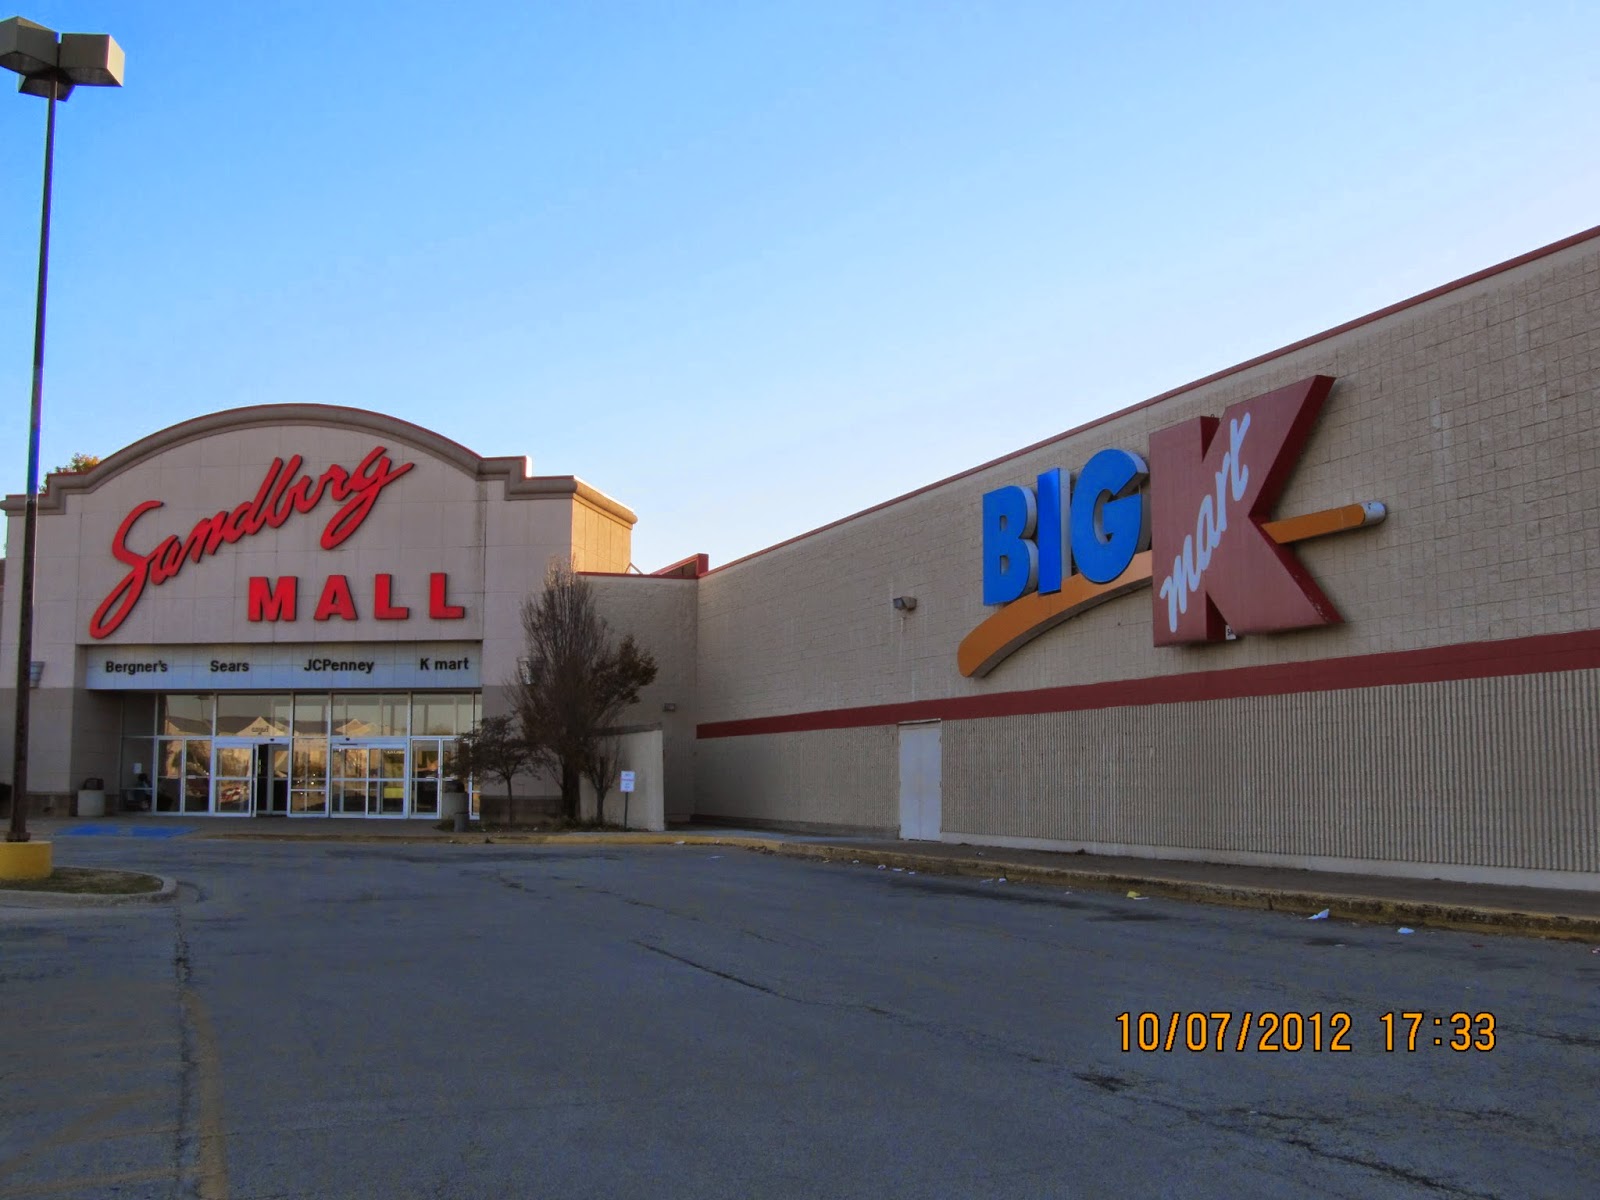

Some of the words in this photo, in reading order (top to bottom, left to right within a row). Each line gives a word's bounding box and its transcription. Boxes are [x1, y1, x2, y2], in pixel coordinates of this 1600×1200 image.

[89, 446, 414, 639] Sandburg
[982, 448, 1147, 606] BIG
[1149, 374, 1340, 647] K
[1159, 412, 1251, 633] mart
[248, 573, 465, 621] MALL
[105, 660, 168, 675] Bergner's
[210, 660, 249, 672] Sears
[303, 658, 374, 674] JCPenney
